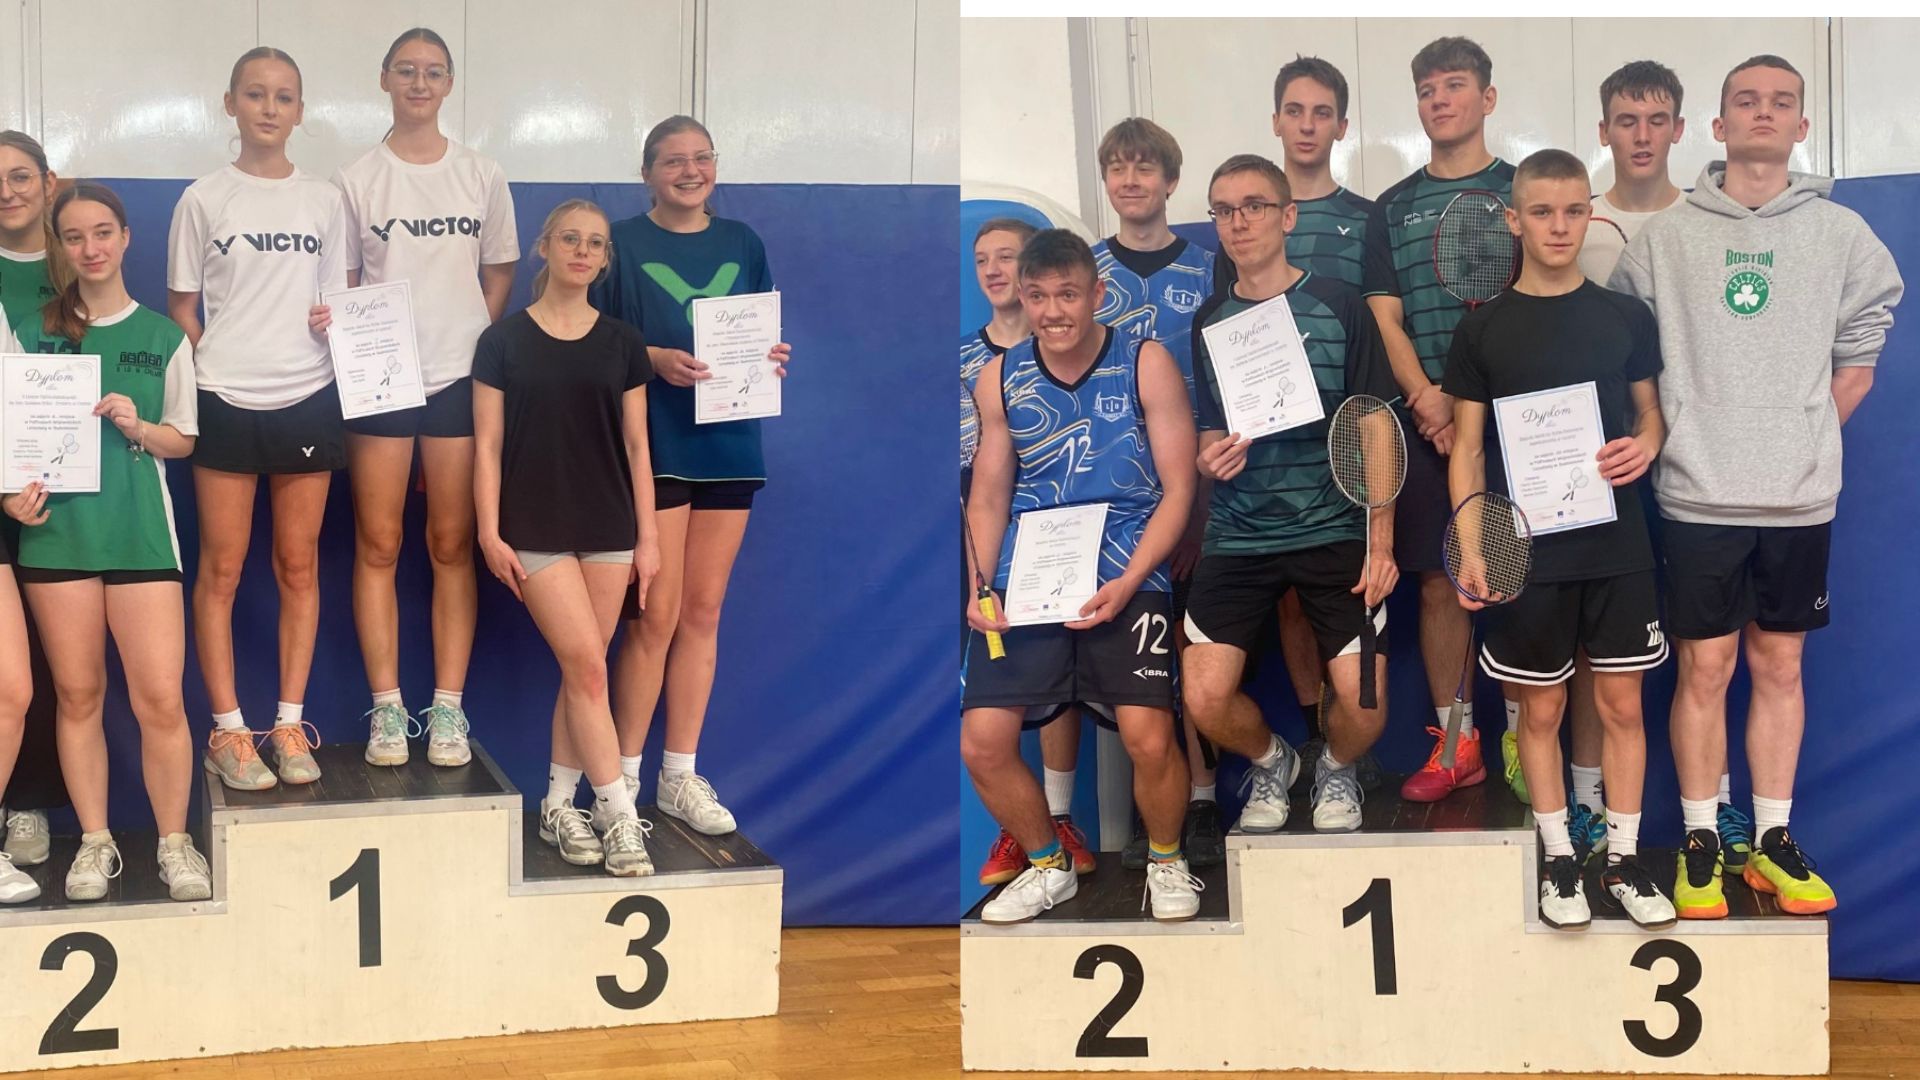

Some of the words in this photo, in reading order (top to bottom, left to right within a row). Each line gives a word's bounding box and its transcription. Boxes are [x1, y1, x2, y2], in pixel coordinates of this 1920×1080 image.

[400, 216, 482, 239] VICTOR
[1726, 249, 1774, 268] BOSTON
[1729, 273, 1767, 292] CELTICS
[345, 299, 389, 319] Dyplom
[715, 309, 758, 327] Dyplom
[1228, 322, 1271, 348] Dyplom
[25, 368, 74, 388] Dyplom
[1522, 405, 1571, 427] Dyplom
[1058, 435, 1093, 478] 12
[1040, 518, 1081, 534] Dyplom
[1131, 611, 1169, 655] 12
[329, 848, 382, 968] 1
[1342, 877, 1398, 996] 1
[595, 895, 671, 1010] 3
[38, 931, 119, 1056] 2
[1072, 943, 1150, 1059] 2
[1622, 938, 1703, 1059] 3
